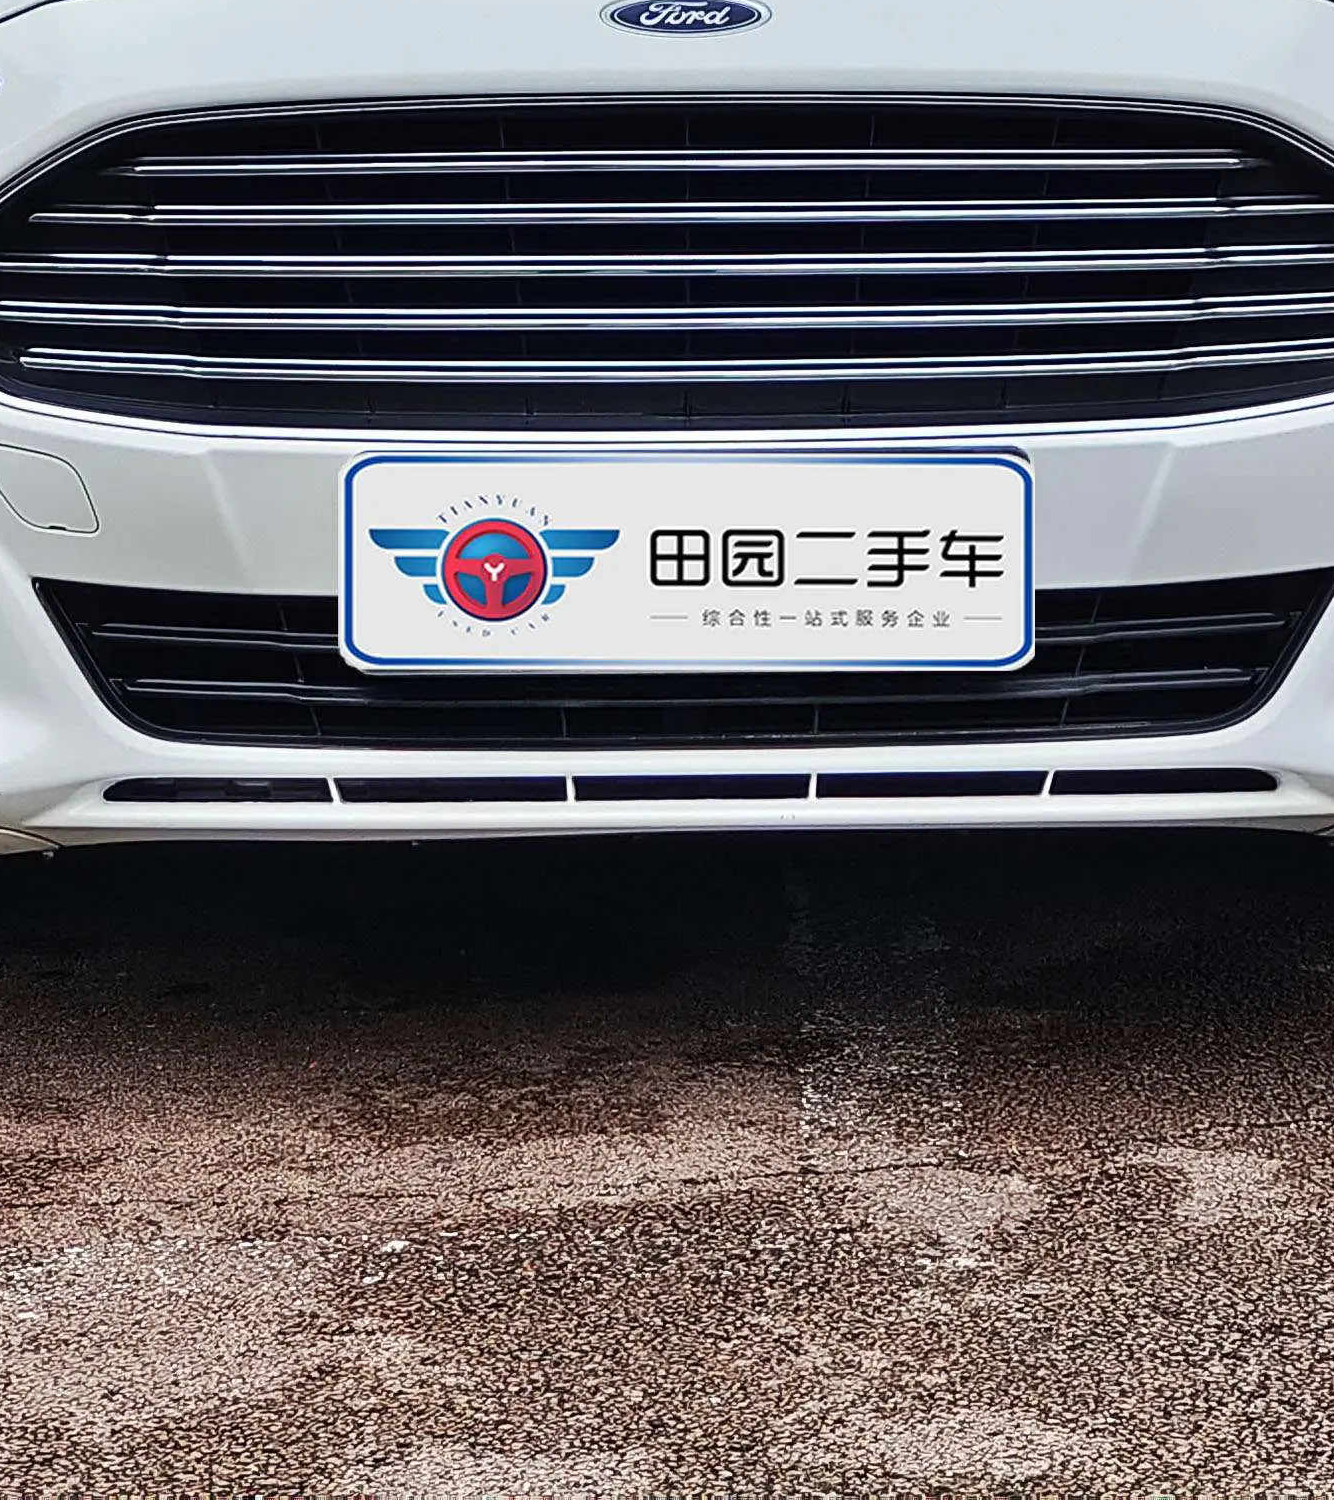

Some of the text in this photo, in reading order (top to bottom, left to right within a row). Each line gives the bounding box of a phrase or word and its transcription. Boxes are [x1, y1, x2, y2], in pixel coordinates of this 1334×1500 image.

[638, 0, 731, 26] Ford
[649, 528, 1005, 589] 田园二手车
[483, 561, 505, 582] Y
[701, 608, 950, 628] 综合性一站式服务企业
